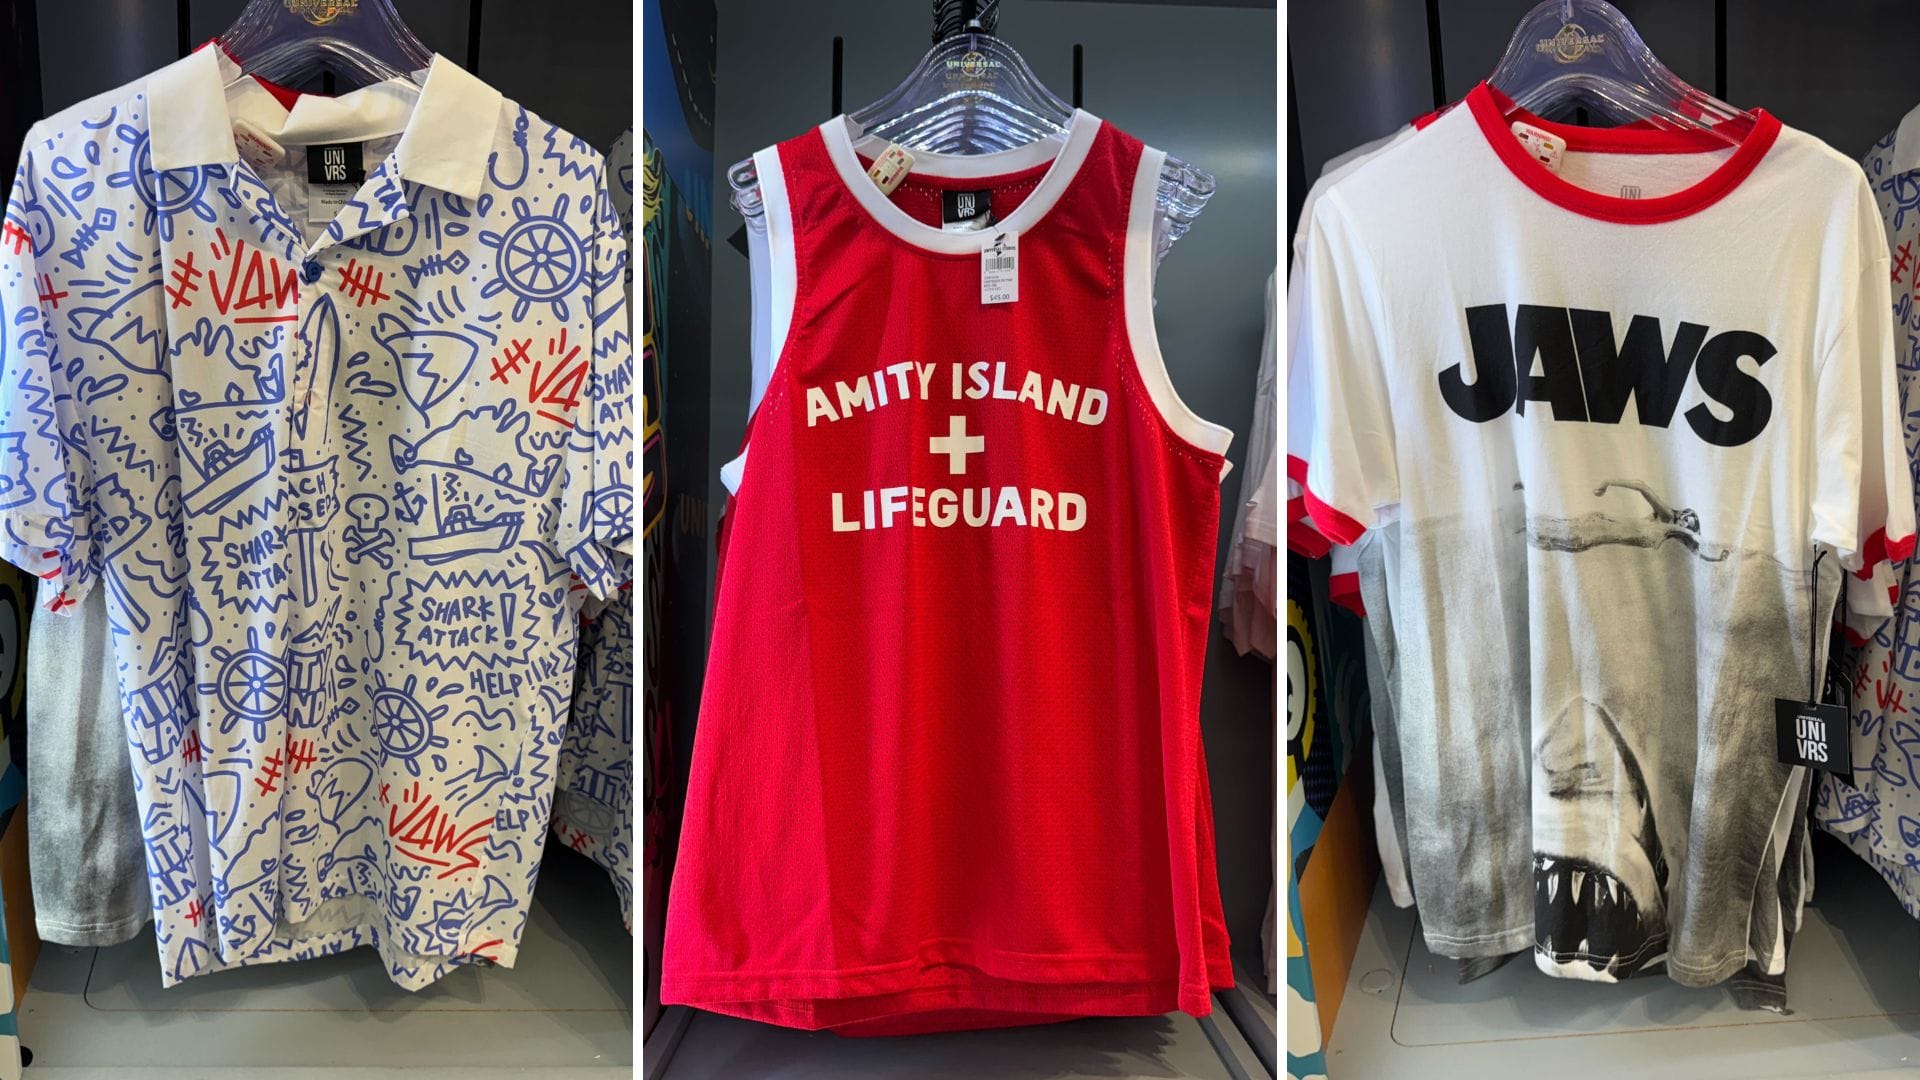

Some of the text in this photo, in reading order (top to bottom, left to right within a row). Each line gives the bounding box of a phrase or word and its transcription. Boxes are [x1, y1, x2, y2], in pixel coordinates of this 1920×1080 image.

[324, 149, 345, 165] UNI
[324, 164, 347, 181] VRS
[1438, 303, 1778, 447] JAWS
[806, 361, 1109, 427] AMITY ISLAND
[832, 486, 1087, 532] LIFEGUARD
[224, 525, 288, 569] SHARK
[418, 595, 495, 625] SHARK
[1796, 718, 1826, 742] UNI
[1796, 739, 1828, 763] VRS
